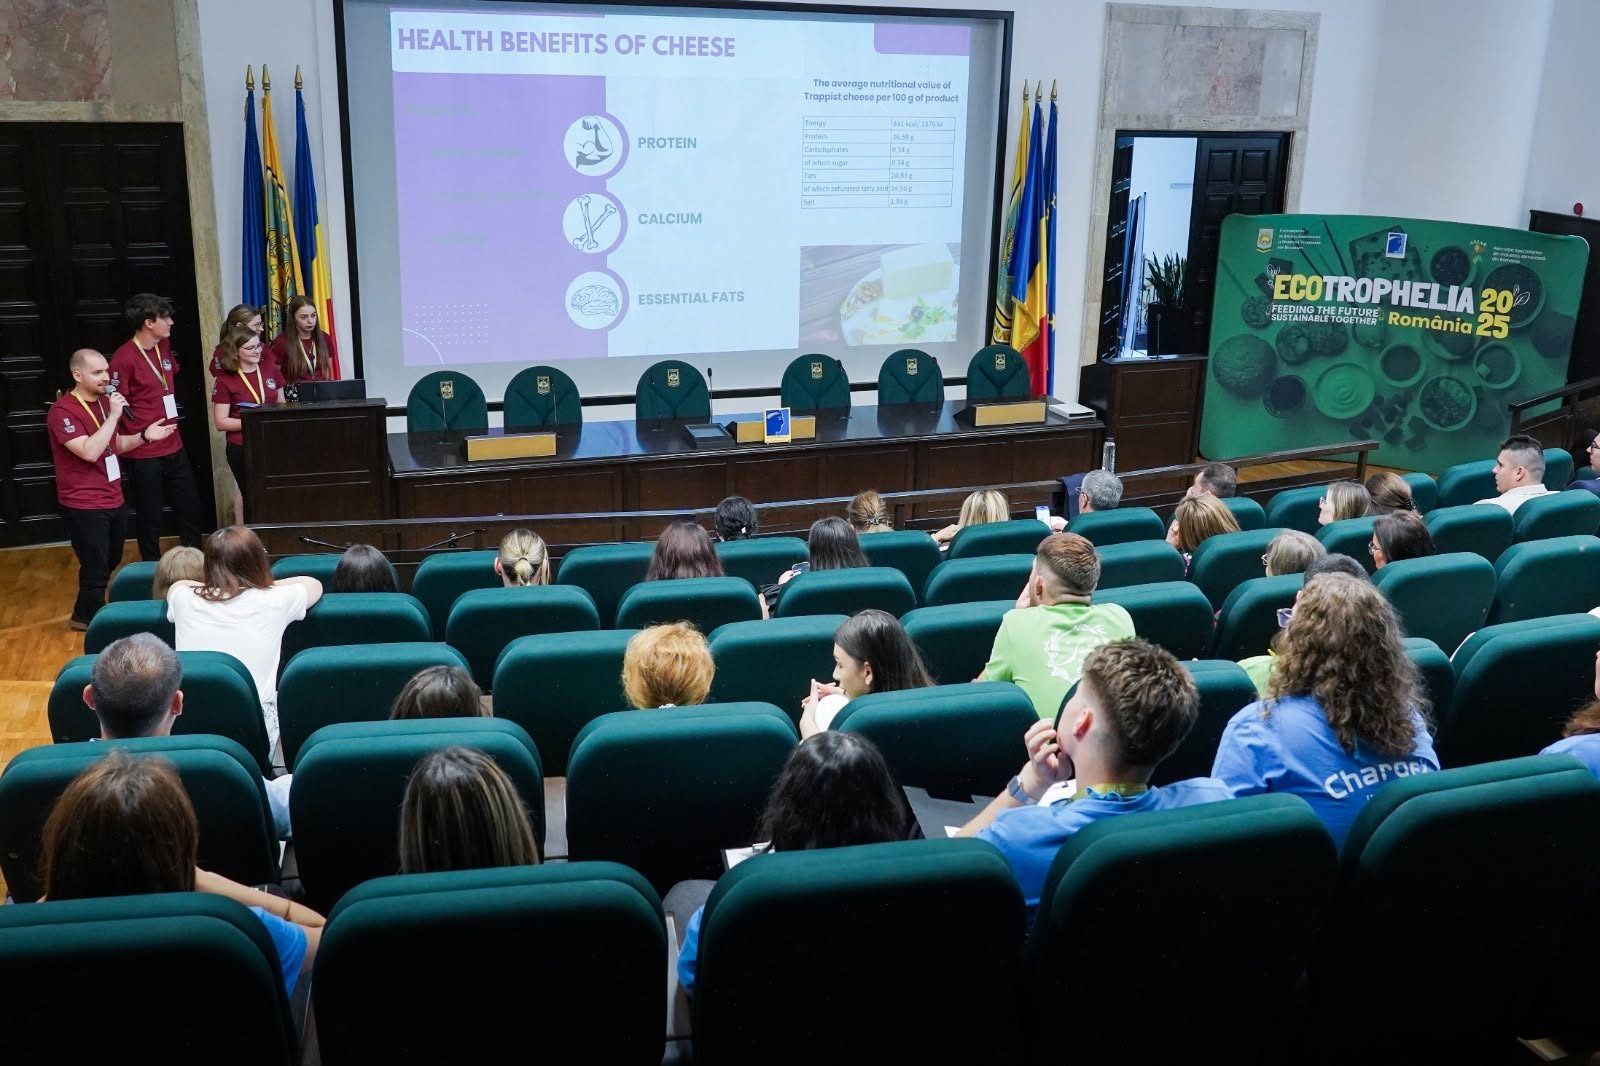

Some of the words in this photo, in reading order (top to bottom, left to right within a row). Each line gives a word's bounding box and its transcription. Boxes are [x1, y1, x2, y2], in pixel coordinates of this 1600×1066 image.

[398, 28, 492, 51] HEALTH
[500, 30, 608, 55] BENEFITS
[614, 34, 646, 56] OF
[652, 35, 735, 58] CHEESE
[813, 78, 830, 87] The
[831, 80, 868, 90] average
[870, 79, 916, 89] nutritional
[917, 81, 941, 89] value
[942, 81, 952, 89] of
[804, 91, 841, 103] Trappist
[843, 92, 874, 101] cheese
[876, 94, 890, 103] per
[892, 93, 906, 101] 100
[907, 95, 914, 104] g
[915, 93, 924, 102] of
[925, 94, 959, 104] product
[805, 119, 827, 128] Energy
[638, 136, 697, 150] PROTEIN
[804, 146, 849, 154] Carbohydrates
[861, 185, 874, 193] fatty
[638, 212, 702, 226] CALCIUM
[638, 292, 709, 305] ESSENTIAL
[711, 290, 745, 303] FATS
[1273, 274, 1474, 314] ECOTROPHELIA
[1480, 288, 1514, 314] 20
[1271, 304, 1315, 314] FEEDING
[1317, 305, 1336, 315] THE
[1337, 306, 1379, 318] FUTURE
[1271, 313, 1329, 323] SUSTAINABLE
[1330, 315, 1378, 326] TOGETHER
[1388, 311, 1472, 334] România
[1476, 312, 1511, 339] 25
